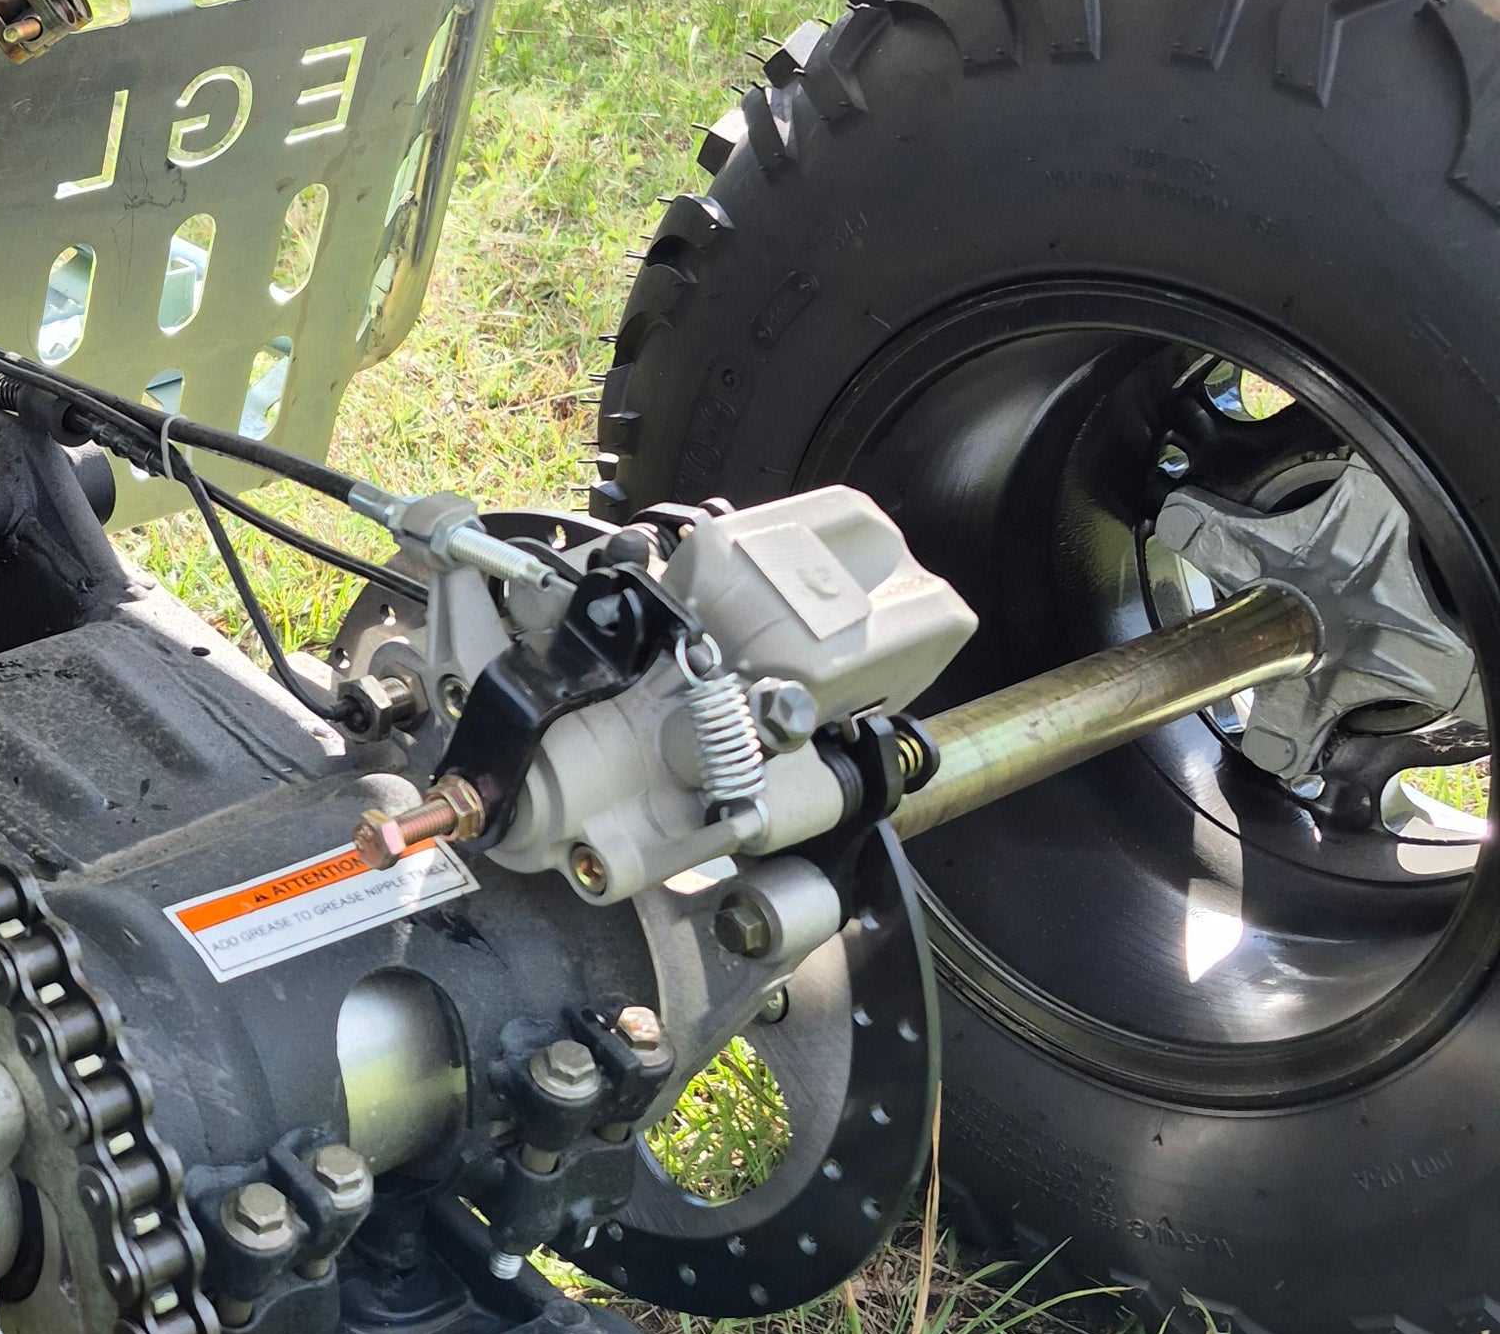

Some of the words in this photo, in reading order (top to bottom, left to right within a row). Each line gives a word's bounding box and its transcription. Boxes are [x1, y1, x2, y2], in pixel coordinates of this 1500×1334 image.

[211, 935, 239, 952] ADD
[240, 915, 292, 942] GREASE
[293, 909, 312, 923] TO
[313, 890, 363, 916] GREASE
[364, 874, 406, 896] NIPPLE
